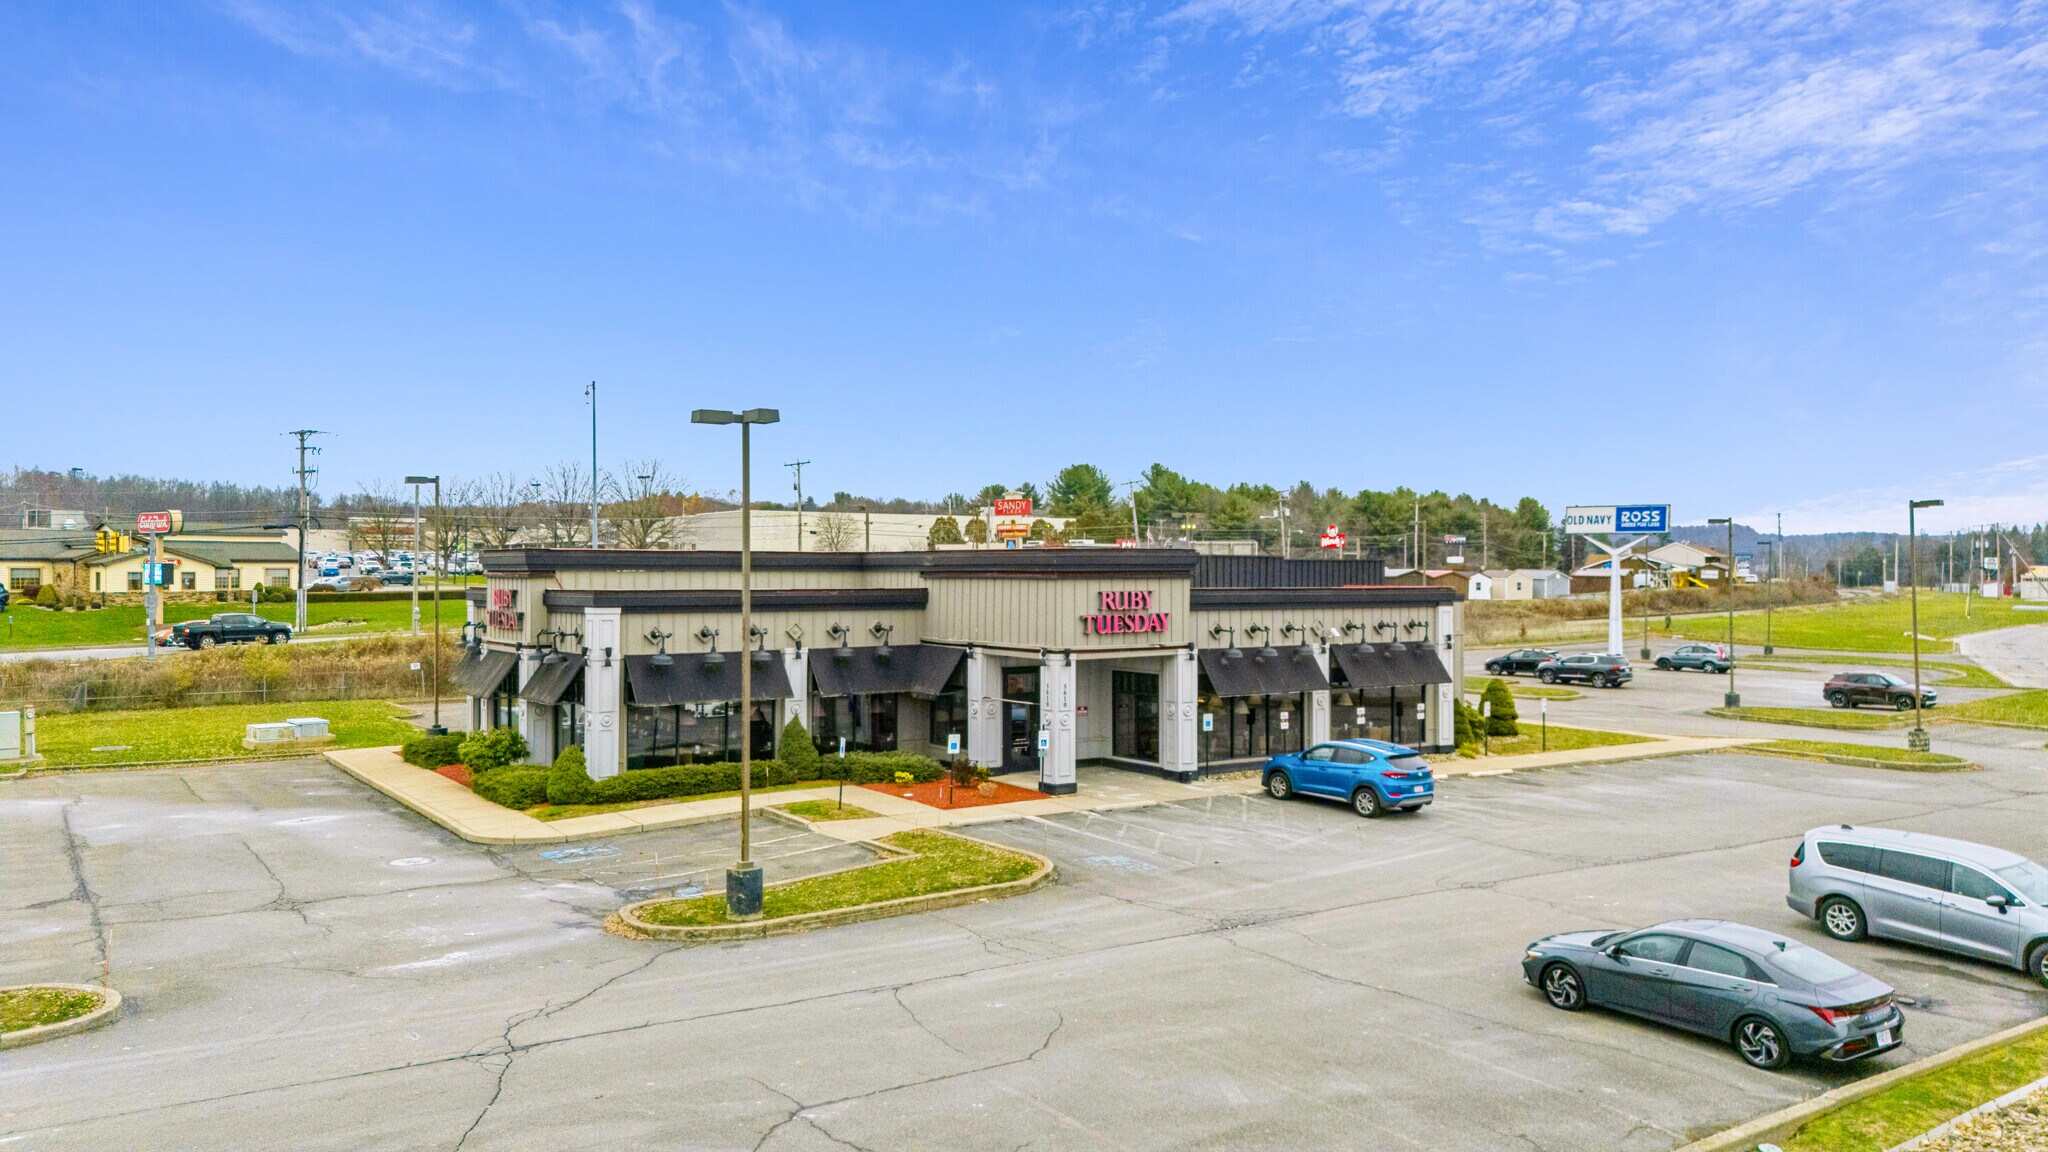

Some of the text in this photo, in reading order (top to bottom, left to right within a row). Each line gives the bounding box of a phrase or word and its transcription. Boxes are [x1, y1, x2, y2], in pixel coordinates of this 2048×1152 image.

[997, 501, 1027, 510] SANDY
[1567, 515, 1612, 525] OLD NAVY
[1621, 511, 1660, 523] ROSS
[493, 589, 518, 607] RUBY
[1099, 591, 1153, 611] RUBY
[487, 610, 524, 631] TUESDAY
[1080, 612, 1170, 635] TUESDAY
